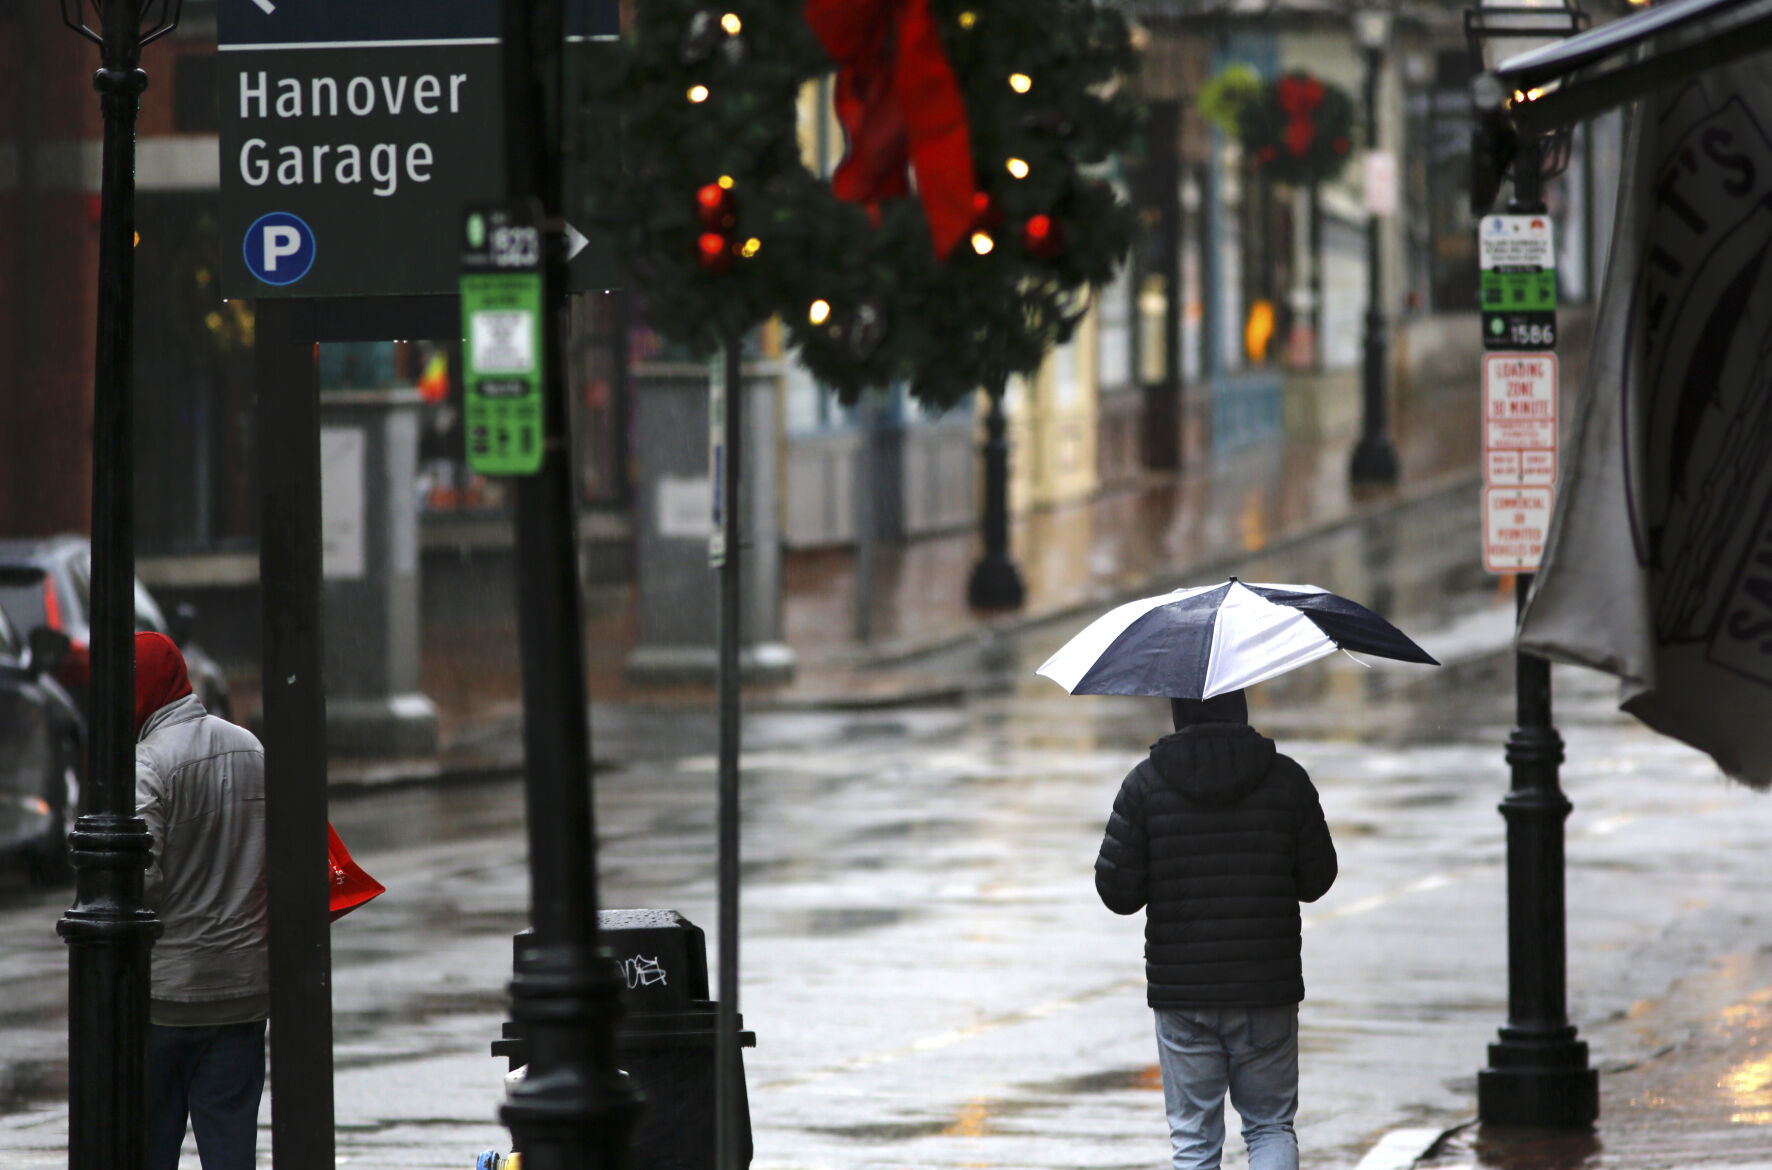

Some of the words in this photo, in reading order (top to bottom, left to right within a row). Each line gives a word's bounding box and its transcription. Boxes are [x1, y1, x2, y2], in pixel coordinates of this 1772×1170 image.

[239, 71, 468, 118] Hanover
[239, 138, 434, 197] Garage
[263, 226, 302, 272] P
[1511, 325, 1554, 344] 1586
[1496, 362, 1544, 379] LOADING
[1506, 382, 1534, 398] ZONE
[1510, 400, 1549, 416] MINUTE
